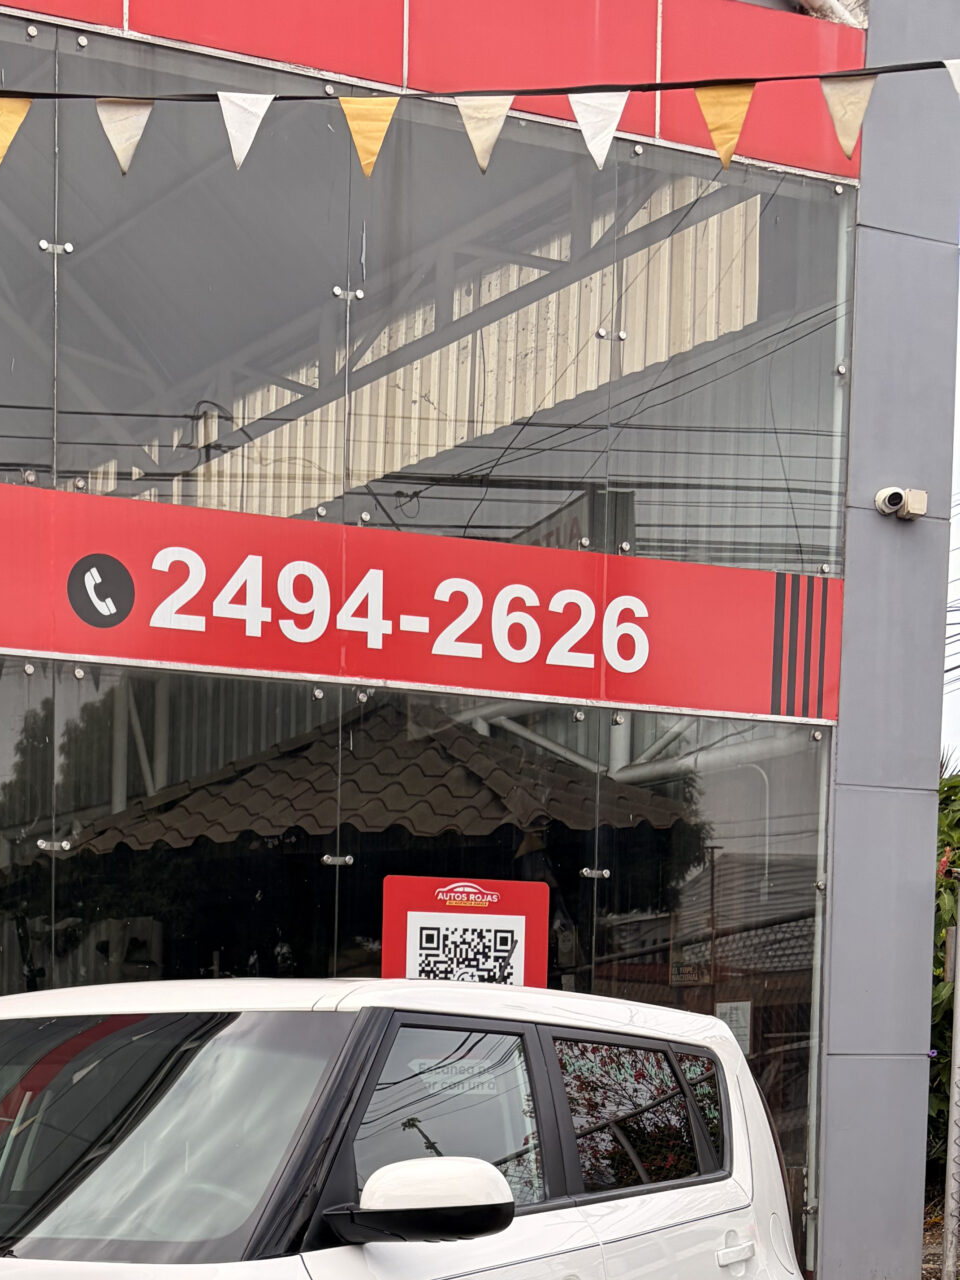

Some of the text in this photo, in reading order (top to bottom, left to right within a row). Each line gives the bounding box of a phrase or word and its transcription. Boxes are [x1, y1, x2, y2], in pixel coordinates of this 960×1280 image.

[148, 546, 650, 673] 2494-2626
[437, 892, 498, 903] AUTOS ROJAS
